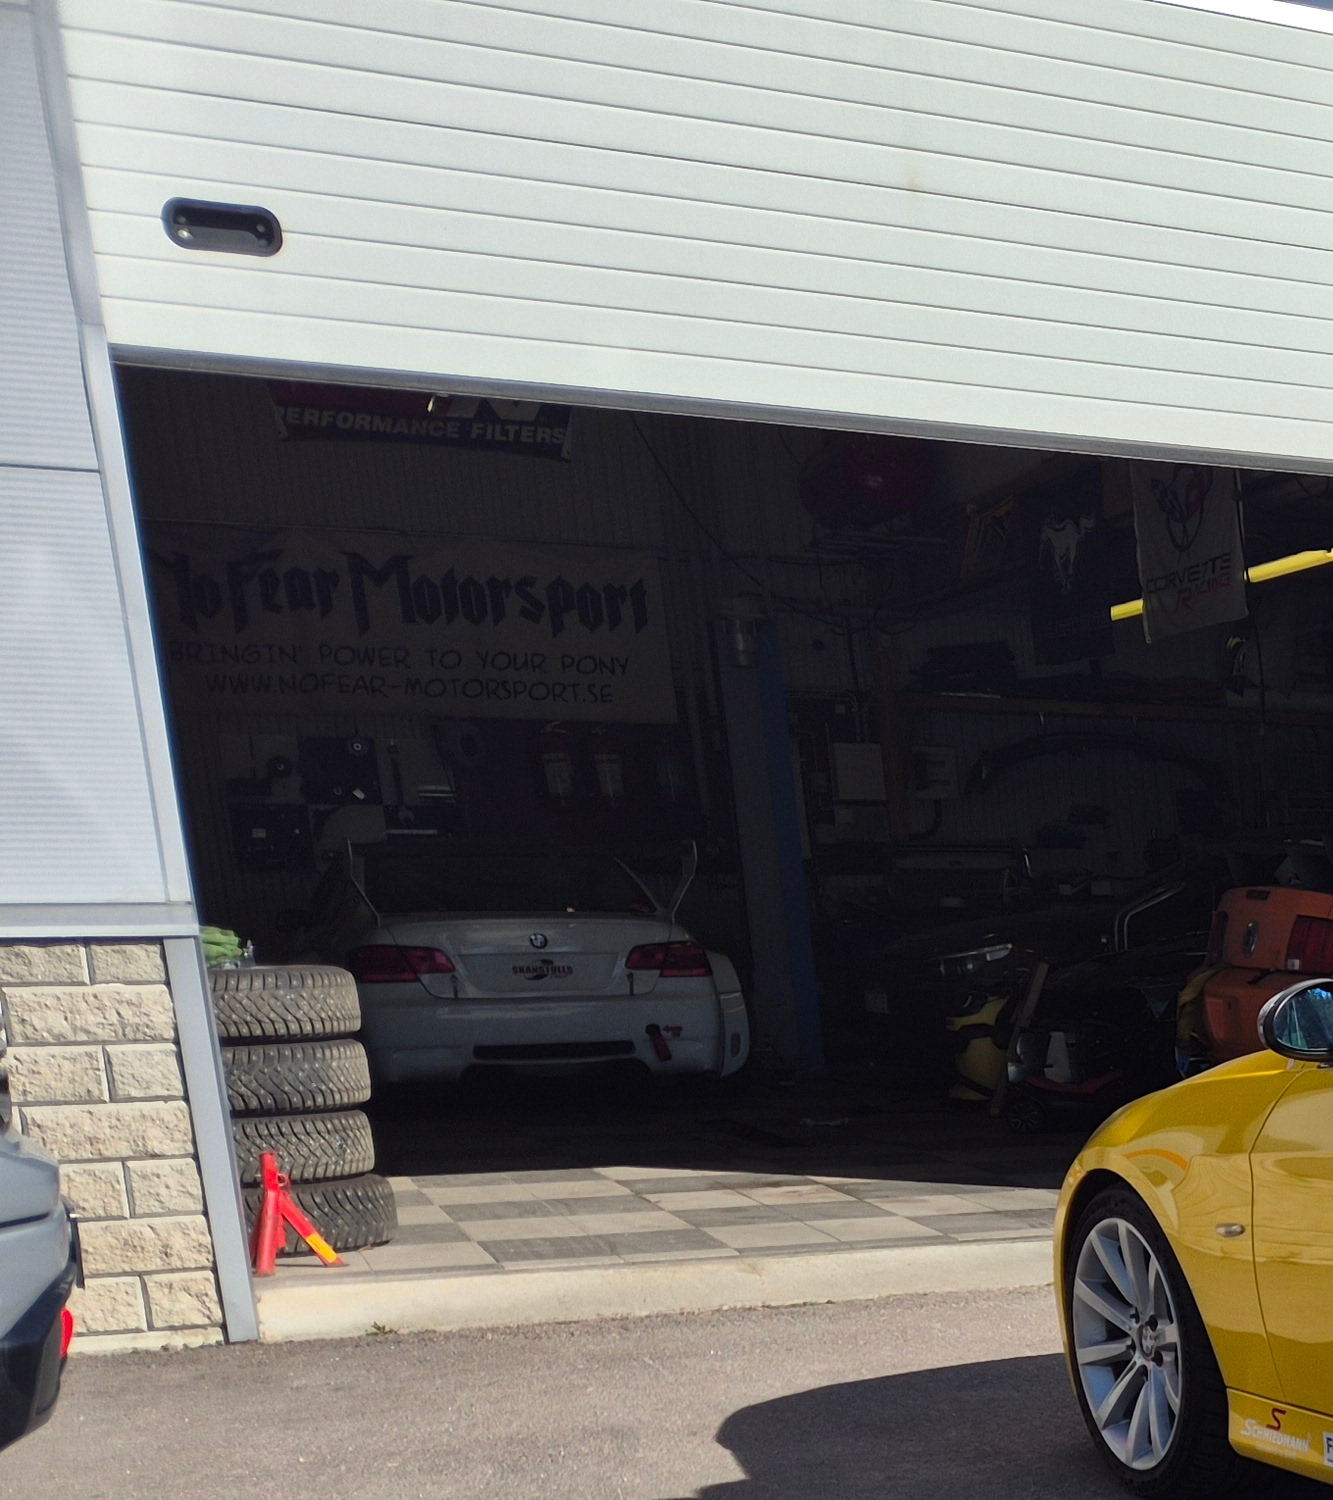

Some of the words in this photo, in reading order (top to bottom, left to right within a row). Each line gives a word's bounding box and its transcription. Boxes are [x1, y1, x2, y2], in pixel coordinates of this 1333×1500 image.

[470, 422, 566, 445] FILTERS
[1146, 552, 1231, 593] CORVETTE
[319, 644, 411, 669] POWER
[427, 649, 462, 670] TO
[475, 650, 547, 674] YOUR
[560, 653, 629, 677] PONY
[205, 671, 613, 703] WWW.NOFEAR-MOTORSPORT.SE
